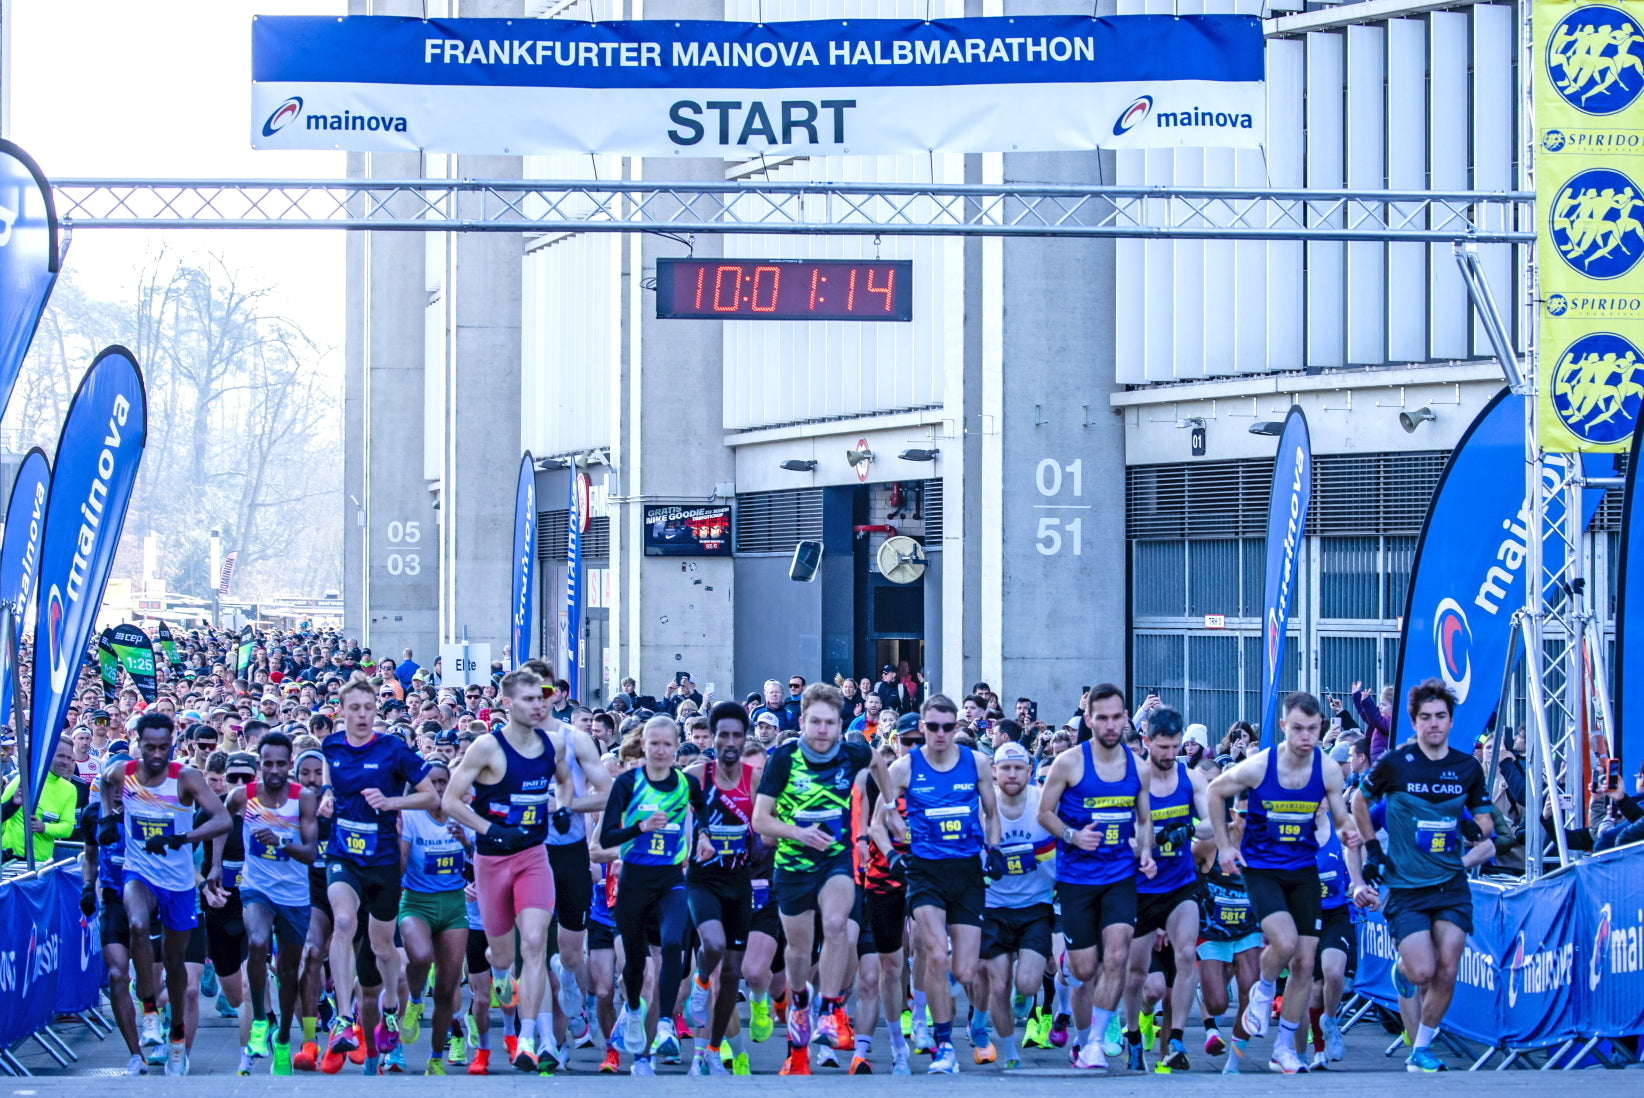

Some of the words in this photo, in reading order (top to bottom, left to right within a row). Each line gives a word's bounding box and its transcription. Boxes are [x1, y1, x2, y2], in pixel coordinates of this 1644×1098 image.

[424, 38, 662, 67] FRANKFURTER
[671, 41, 820, 67] MAINOVA
[828, 36, 1095, 65] HALBMARATHON
[306, 109, 408, 133] mainova
[667, 99, 857, 146] START
[1156, 106, 1253, 129] mainova
[1568, 133, 1644, 147] SPIRIDO
[1191, 434, 1203, 448] 01
[1035, 458, 1082, 497] 01
[66, 393, 131, 602] mainova
[646, 514, 668, 525] NIKE
[668, 508, 706, 521] GOODIE
[648, 506, 682, 517] GRATIS
[387, 521, 421, 543] 05
[1035, 517, 1082, 556] 51
[387, 553, 421, 575] 03
[125, 633, 143, 644] cep
[126, 656, 153, 671] 1:25
[455, 658, 477, 671] Elte
[1407, 782, 1429, 793] REA
[1432, 784, 1463, 794] CARD
[522, 810, 537, 821] 91
[939, 819, 962, 833] 160
[1278, 824, 1301, 835] 159
[1105, 829, 1119, 840] 55
[345, 837, 367, 850] 100
[650, 838, 665, 851] 13
[723, 840, 729, 850] 1
[1431, 837, 1446, 849] 96
[436, 856, 454, 868] 161
[1007, 860, 1022, 871] 64
[1220, 911, 1246, 921] 5814
